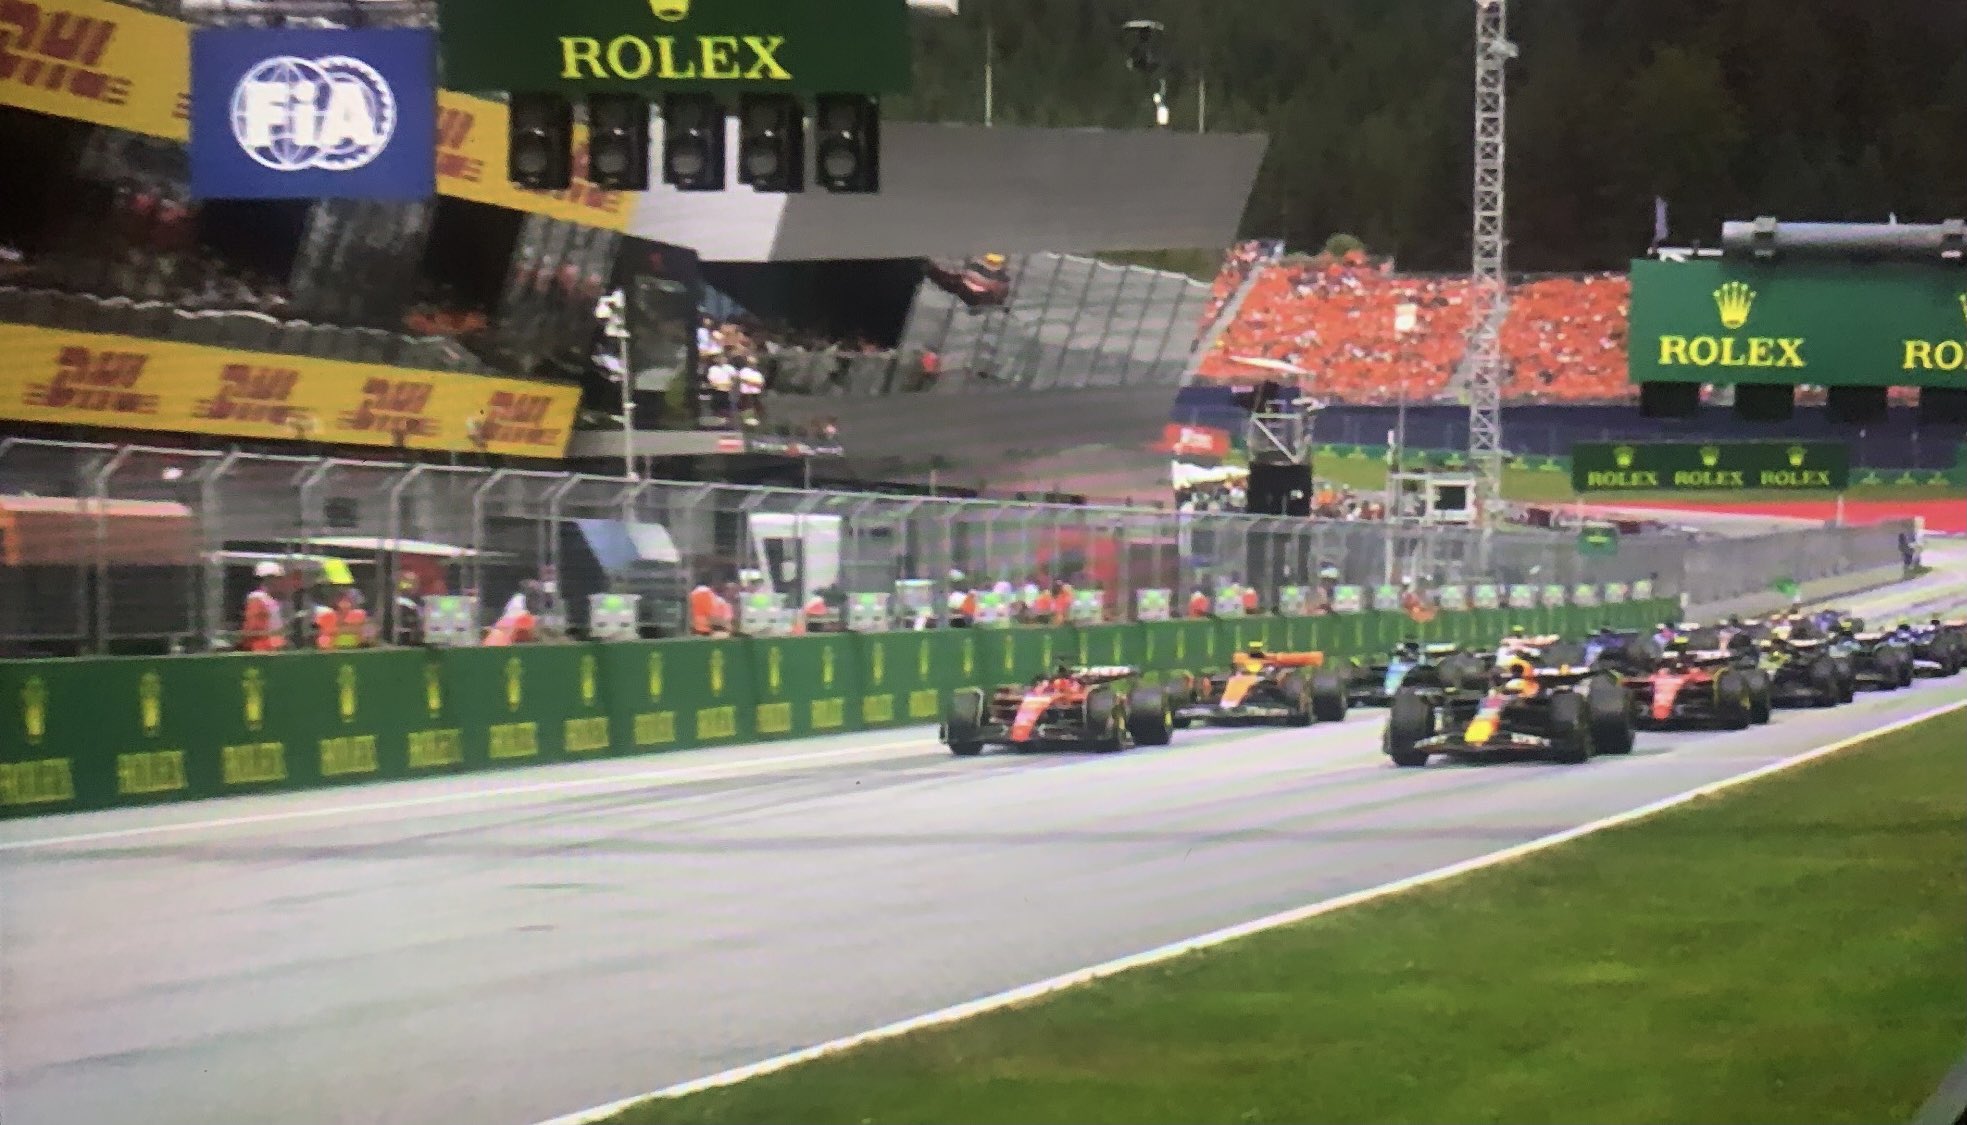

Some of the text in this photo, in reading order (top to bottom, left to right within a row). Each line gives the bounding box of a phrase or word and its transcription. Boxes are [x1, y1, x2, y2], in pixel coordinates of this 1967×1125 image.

[558, 35, 794, 80] ROLEX
[1658, 335, 1967, 370] ROLEX RO
[1587, 469, 1830, 486] ROLEX ROLEX ROLEX
